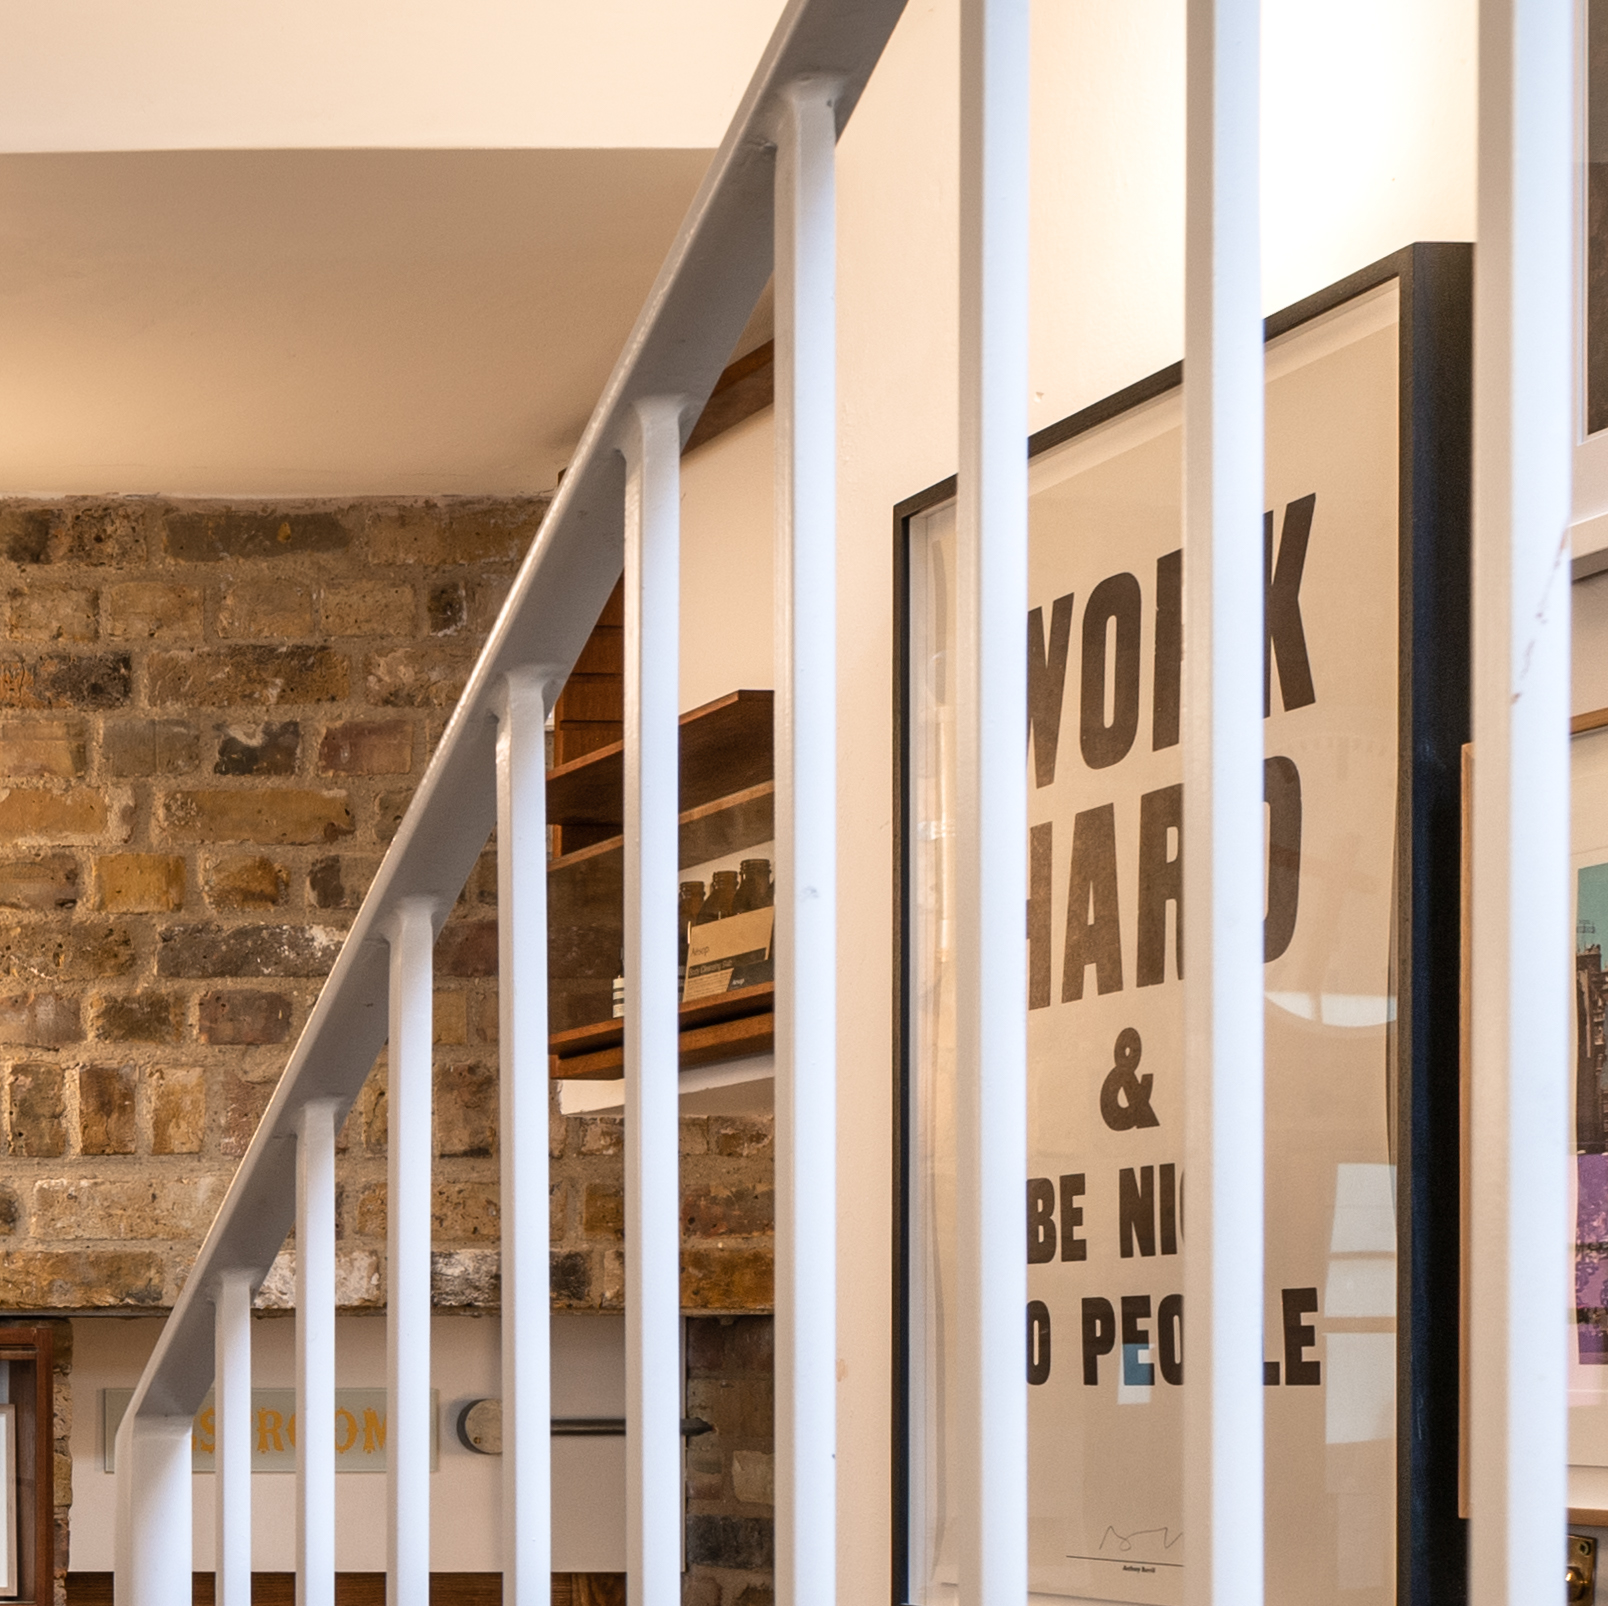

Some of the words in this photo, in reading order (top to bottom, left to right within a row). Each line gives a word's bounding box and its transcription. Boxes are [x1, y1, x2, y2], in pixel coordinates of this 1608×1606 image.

[1100, 1027, 1160, 1132] &
[1119, 1162, 1184, 1259] NI
[1081, 1287, 1321, 1387] PEOE
